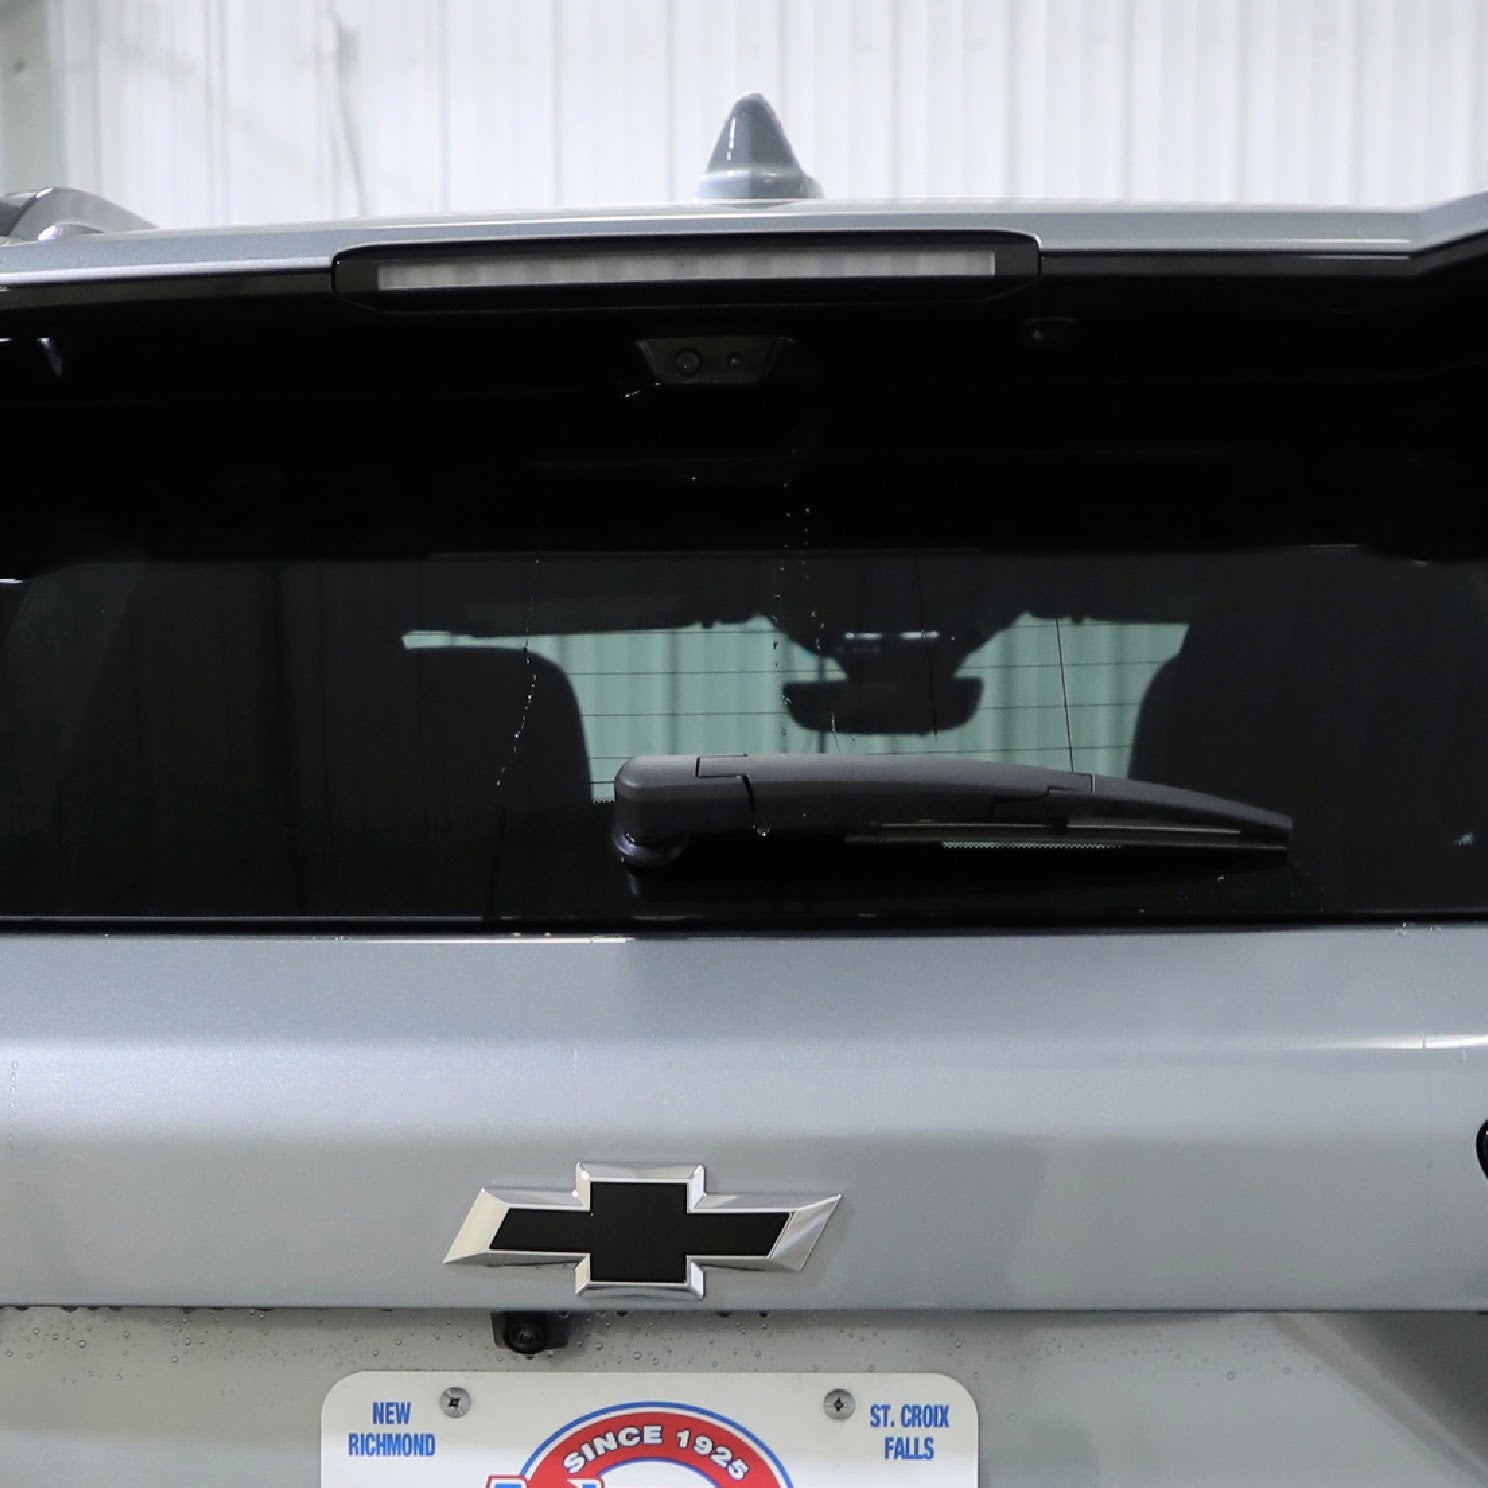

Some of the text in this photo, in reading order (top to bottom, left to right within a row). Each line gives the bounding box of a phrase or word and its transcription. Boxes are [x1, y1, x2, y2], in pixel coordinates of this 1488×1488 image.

[372, 1402, 412, 1425] NEW
[869, 1404, 951, 1429] ST. CROIX
[348, 1433, 436, 1457] RICHMOND
[563, 1425, 751, 1482] SINCE 1925
[884, 1437, 935, 1461] FALLS
